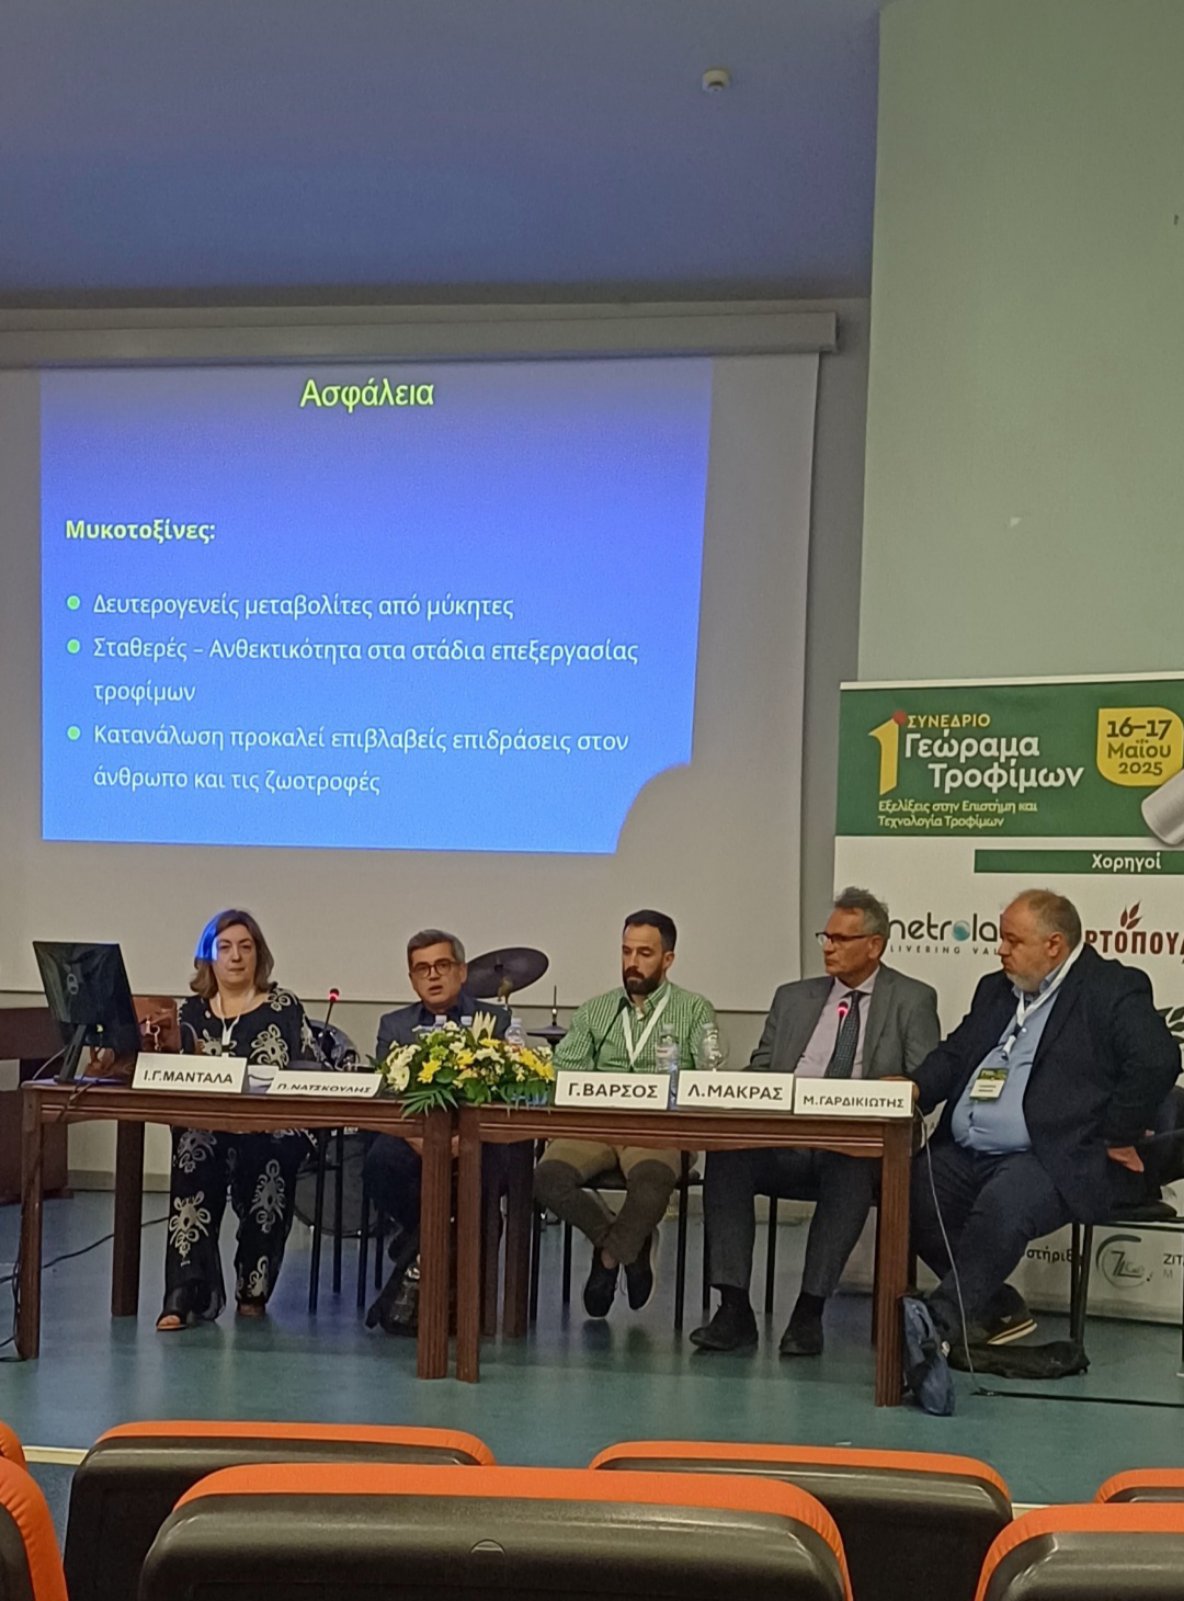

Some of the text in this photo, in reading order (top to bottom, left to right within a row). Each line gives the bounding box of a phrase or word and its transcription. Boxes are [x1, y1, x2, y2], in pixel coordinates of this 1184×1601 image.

[301, 378, 433, 413] Ασφάλεια
[67, 519, 214, 543] Μυκοτοξίνες:
[94, 593, 513, 620] Δευτερογενείς μεταβολίτες από μύκητες
[94, 637, 187, 662] Σταθερές
[210, 638, 361, 664] Ανθεκτικότητα
[368, 645, 405, 659] στα
[413, 639, 485, 660] στάδια
[492, 639, 637, 665] επεξεργασίας
[95, 680, 195, 705] τροφίμων
[906, 713, 991, 729] ΣΥΝΕΔΡΙΟ
[95, 725, 628, 755] Κατανάλωση προκαλεί επιβλαβείς επιδράσεις στον
[904, 729, 1040, 763] Γεώραμα
[94, 766, 379, 796] άνθρωπο και τις ζωοτροφές
[927, 759, 1085, 794] Τροφίμων
[1118, 762, 1163, 776] 2025
[878, 799, 1038, 814] Εξελίξεις στην Επιστήμη και
[878, 813, 1005, 829] Τεχνολογία Τροφίμων
[1092, 853, 1162, 872] Χορηγοί
[568, 1083, 658, 1099] Γ.ΒΑΡΣΟΣ
[687, 1083, 784, 1101] Λ.ΜΑΚΡΑΣ
[803, 1096, 904, 1109] Μ.ΓΑΡΔΙΚΙΩΤΗΣ
